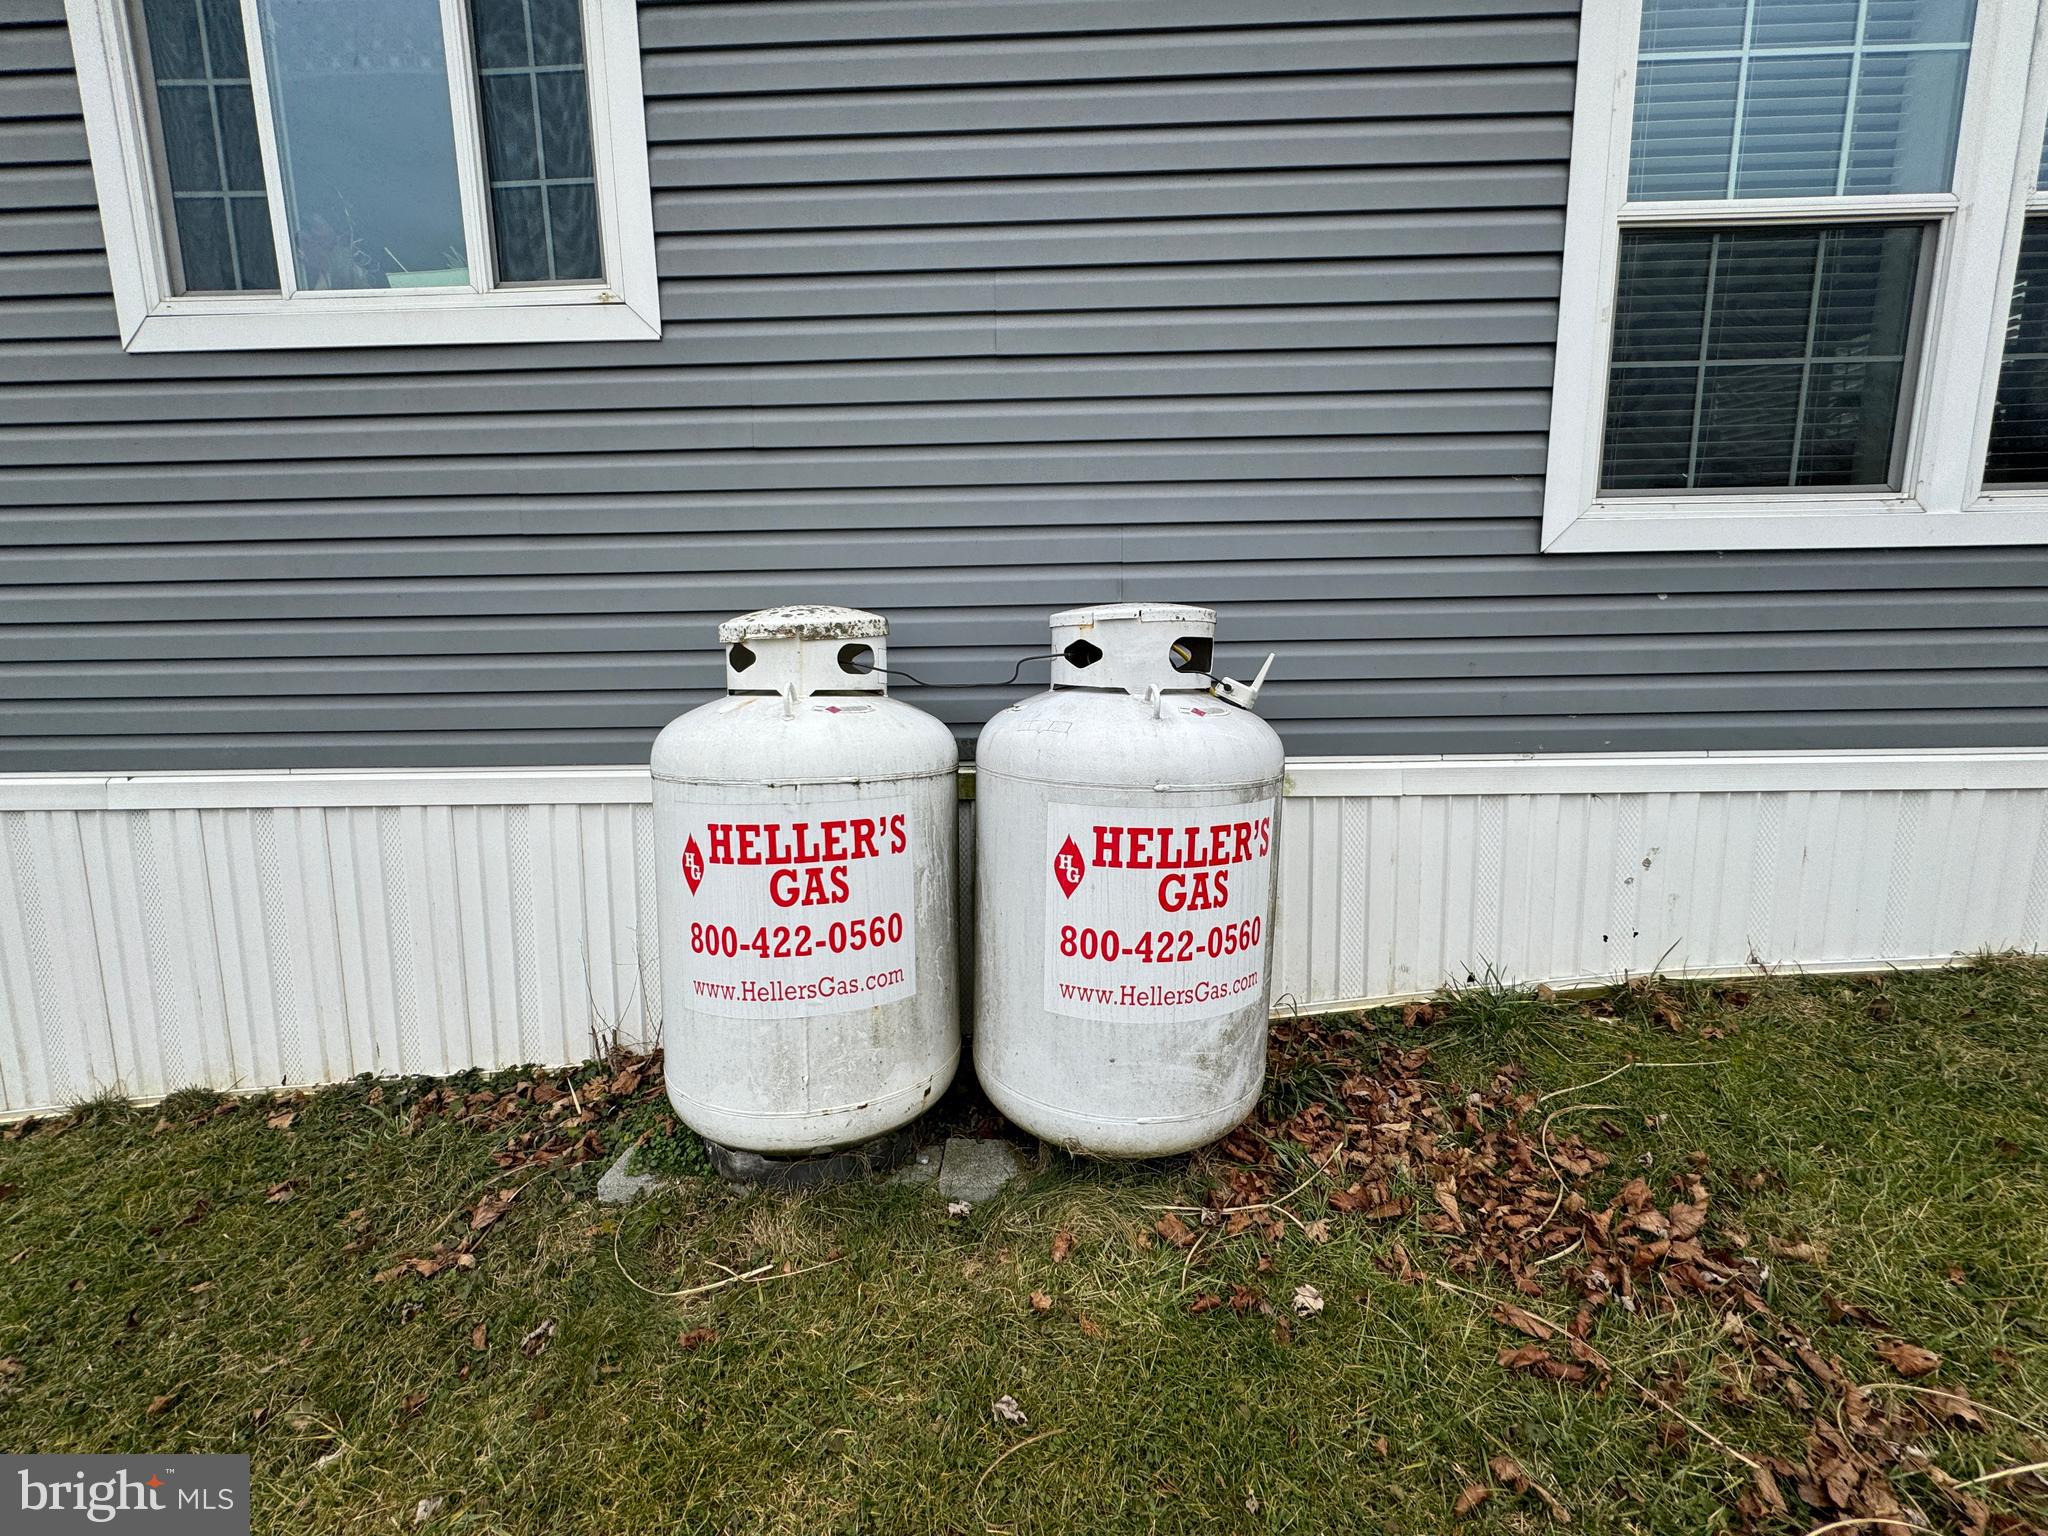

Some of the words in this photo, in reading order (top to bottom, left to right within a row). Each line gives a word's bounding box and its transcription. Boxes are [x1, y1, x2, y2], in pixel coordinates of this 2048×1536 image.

[707, 814, 907, 865] HELLER'S
[1092, 817, 1270, 869] HELLER'S
[769, 865, 850, 907] GAS
[1158, 870, 1229, 912] GAS
[690, 912, 903, 958] 800-422-0560
[1060, 916, 1261, 963] 800-422-0560
[693, 968, 904, 1002] www.HellersGas.com
[1059, 971, 1258, 1007] www.HellersGas.com
